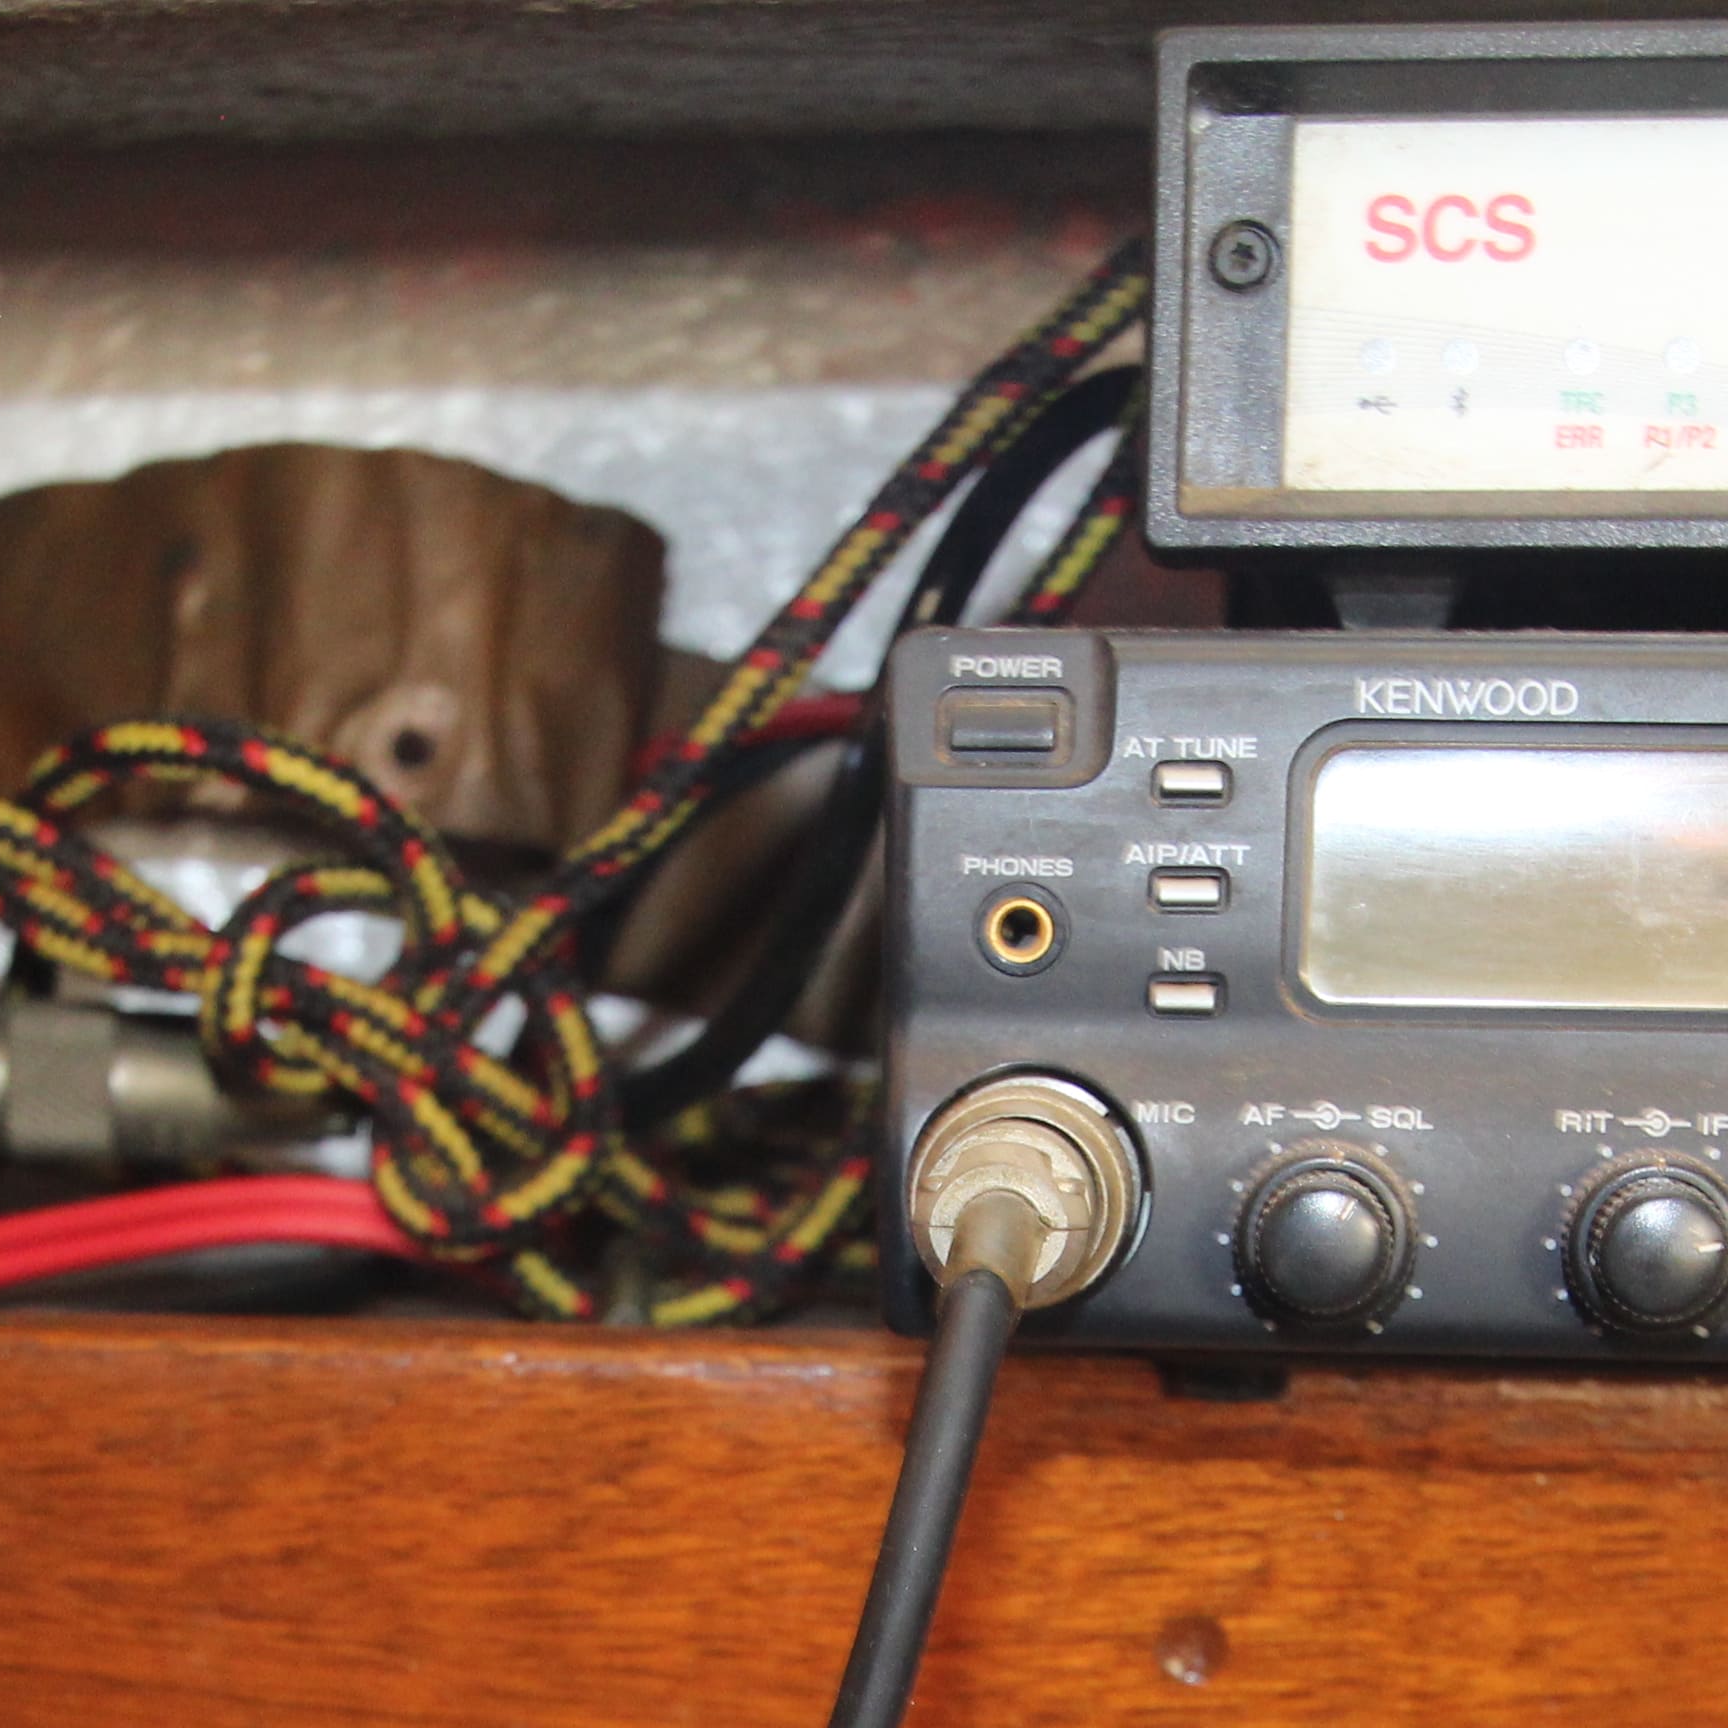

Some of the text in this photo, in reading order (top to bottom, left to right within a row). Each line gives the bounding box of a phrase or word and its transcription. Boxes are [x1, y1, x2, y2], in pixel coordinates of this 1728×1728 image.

[1365, 195, 1536, 263] SCS
[1554, 425, 1605, 449] ERR
[953, 656, 1063, 680] POWER
[1356, 679, 1579, 716] KENWOOD
[1124, 736, 1258, 760] AT TUNE
[963, 855, 1074, 878] PHONES
[1124, 843, 1250, 867] AIP/ATT
[1158, 947, 1206, 972] NB
[1136, 1104, 1195, 1126] MIC
[1243, 1106, 1434, 1131] AF SQL
[1556, 1110, 1614, 1135] RIT
